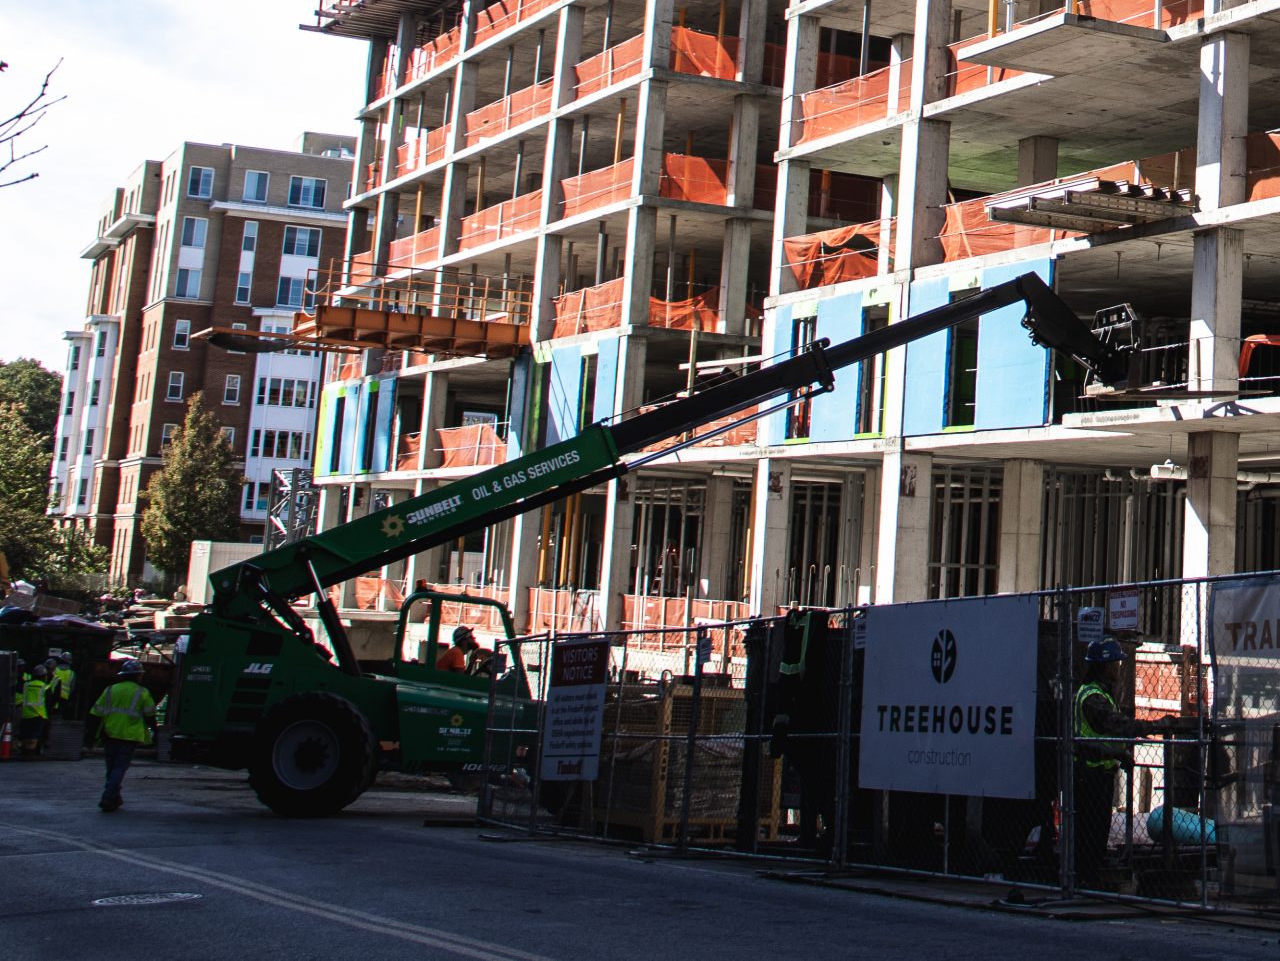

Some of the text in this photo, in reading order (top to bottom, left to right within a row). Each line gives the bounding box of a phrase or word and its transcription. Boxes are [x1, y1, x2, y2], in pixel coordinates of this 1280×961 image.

[471, 450, 581, 501] OIL & GAS SERVICES
[406, 494, 462, 524] SUNBELT
[416, 508, 457, 526] RENTALS
[561, 647, 598, 663] VISITORS
[243, 662, 274, 674] JLG
[562, 666, 593, 680] NOTICE
[877, 705, 1013, 735] TREEHOUSE
[907, 749, 971, 766] construction
